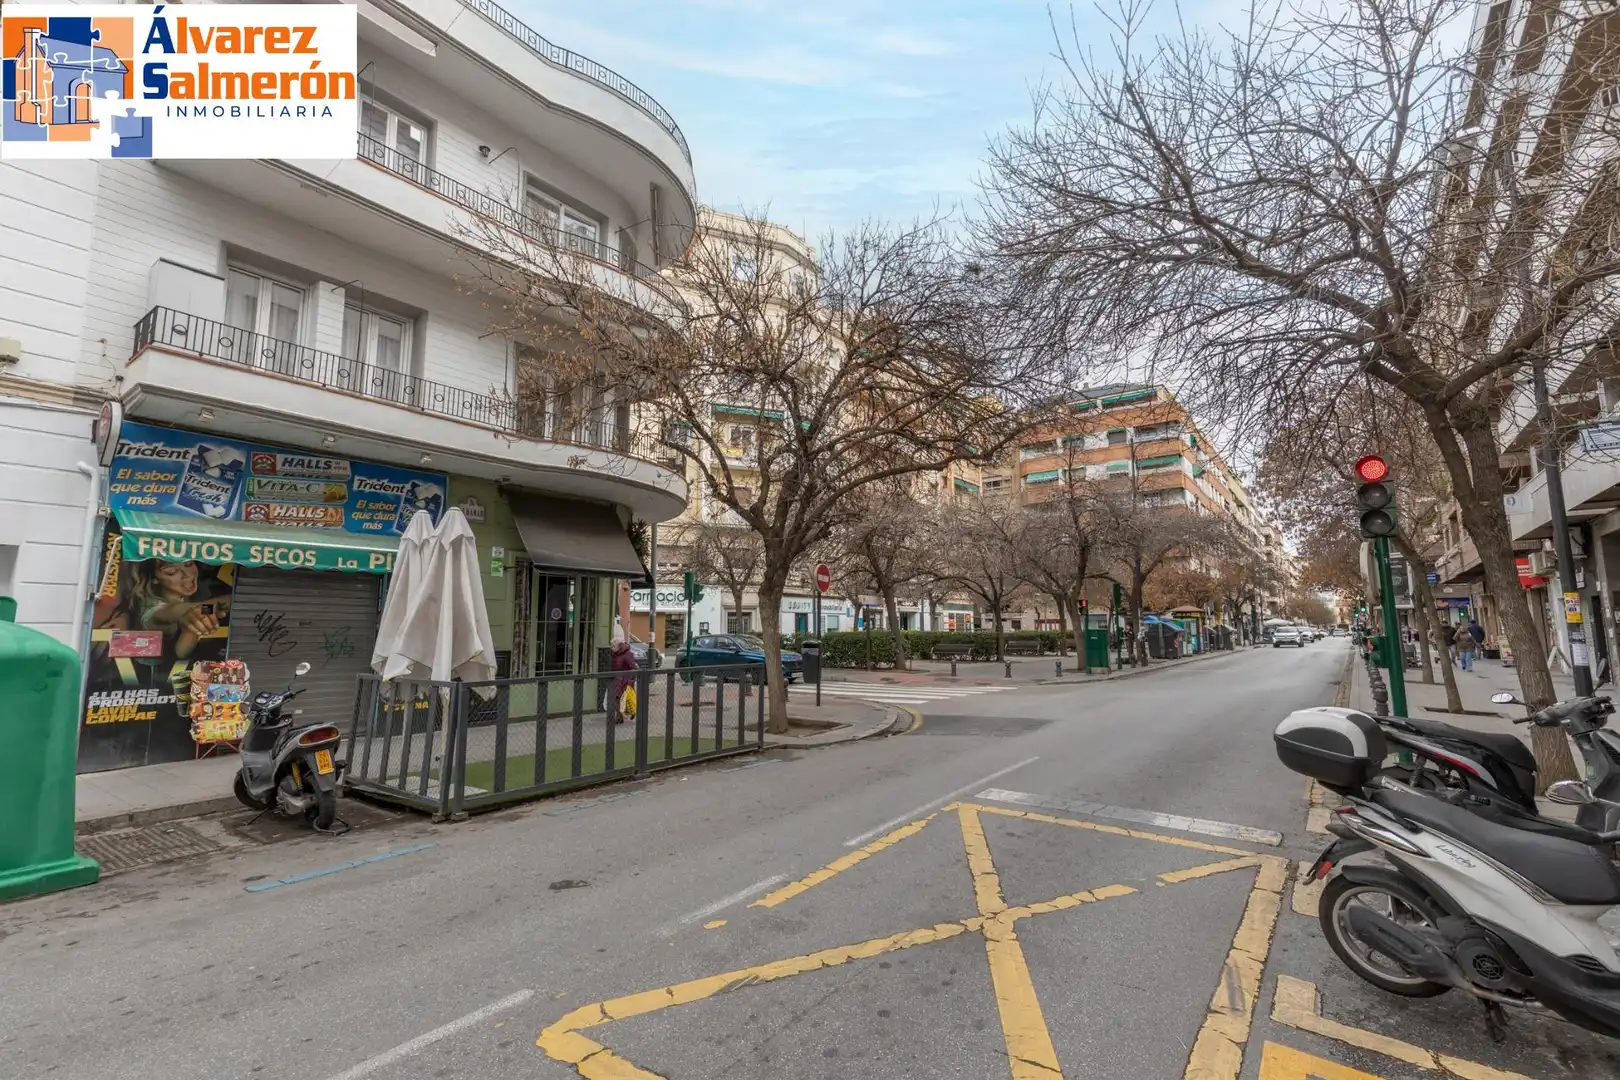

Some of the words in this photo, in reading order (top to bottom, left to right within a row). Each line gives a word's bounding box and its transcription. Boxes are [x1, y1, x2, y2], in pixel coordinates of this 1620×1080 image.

[115, 442, 190, 460] Trident
[281, 457, 332, 470] HALLS
[117, 468, 130, 479] El
[134, 469, 176, 481] sabor
[110, 483, 140, 494] que
[143, 482, 177, 493] dura
[185, 474, 231, 494] Trident
[357, 479, 406, 493] Trident
[126, 494, 158, 505] más
[356, 500, 367, 509] El
[368, 500, 396, 511] sabor
[274, 505, 326, 519] HALLS
[352, 511, 371, 520] que
[372, 510, 397, 520] dura
[362, 520, 383, 529] más
[137, 536, 234, 561] FRUTOS
[249, 545, 316, 567] SECOS
[124, 688, 160, 699] HAS
[88, 694, 177, 708] PROBADO?
